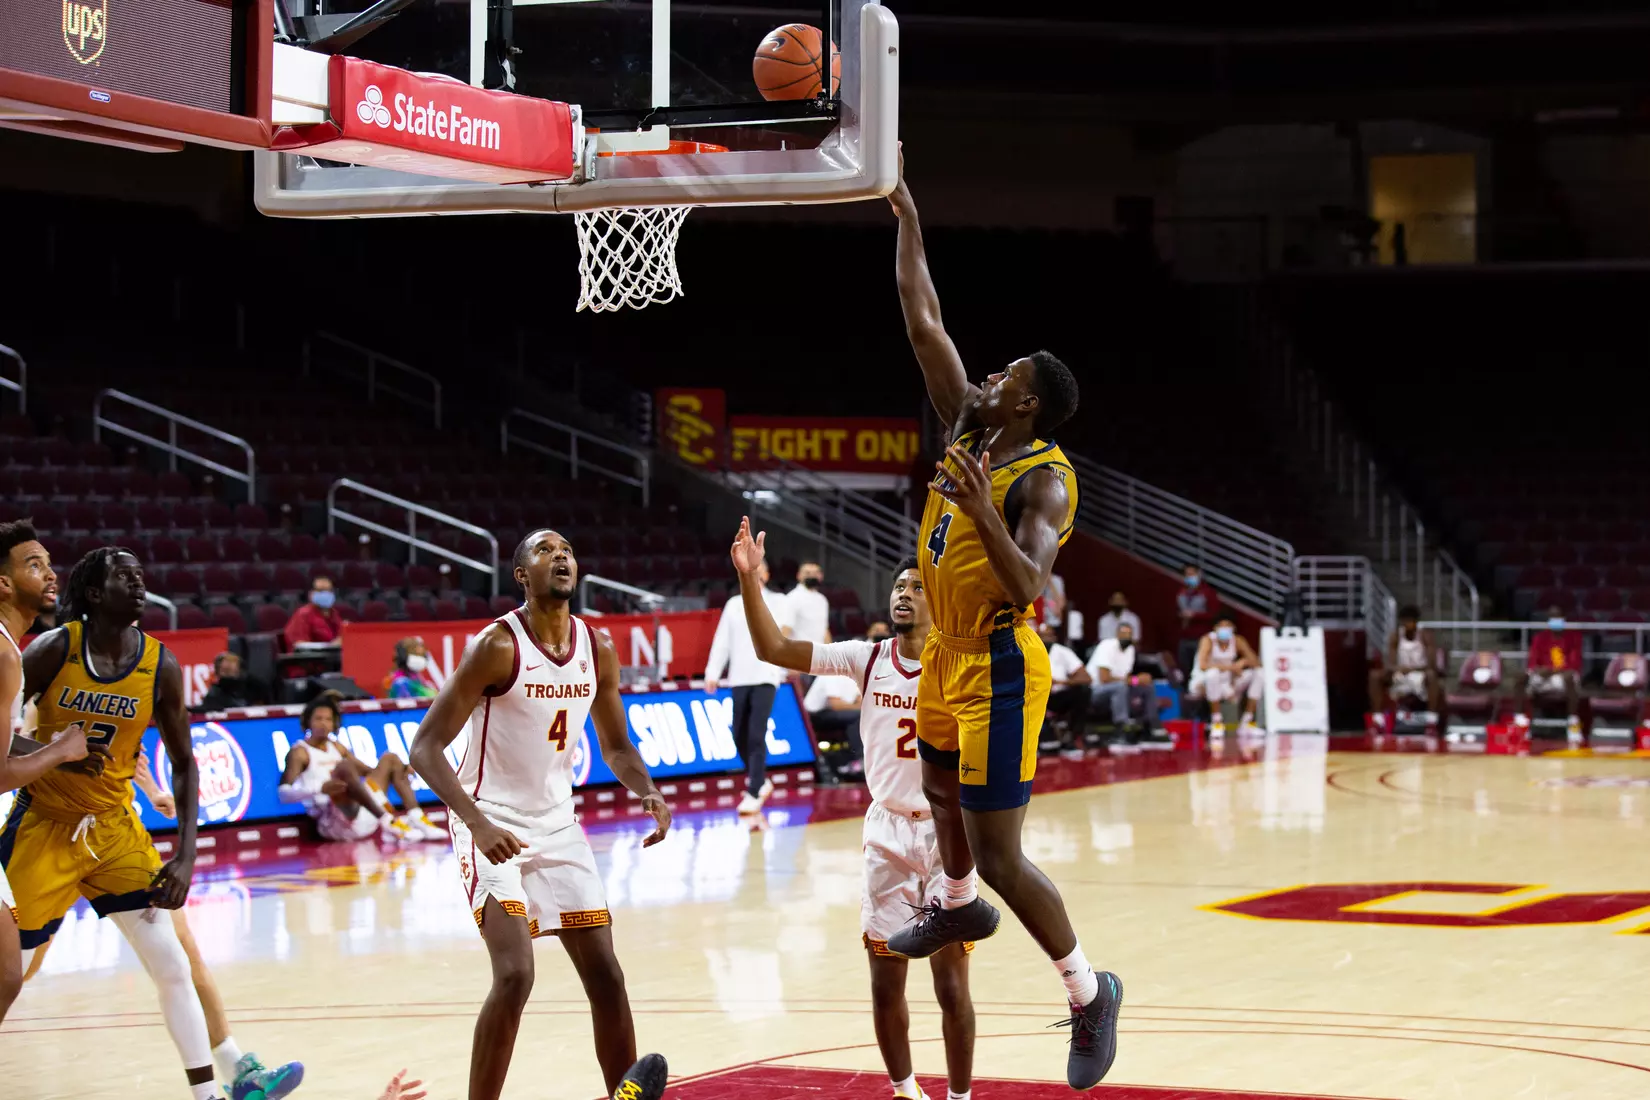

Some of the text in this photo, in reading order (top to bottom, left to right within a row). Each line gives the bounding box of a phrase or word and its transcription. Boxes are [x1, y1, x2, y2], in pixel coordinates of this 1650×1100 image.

[67, 2, 103, 50] ups
[731, 427, 849, 461] FIGHT
[926, 511, 954, 569] 4
[57, 685, 141, 720] LANCERS
[524, 683, 591, 699] TROJANS
[69, 719, 119, 749] 2
[547, 708, 569, 752] 4
[628, 701, 696, 767] SUB
[896, 717, 917, 760] 2
